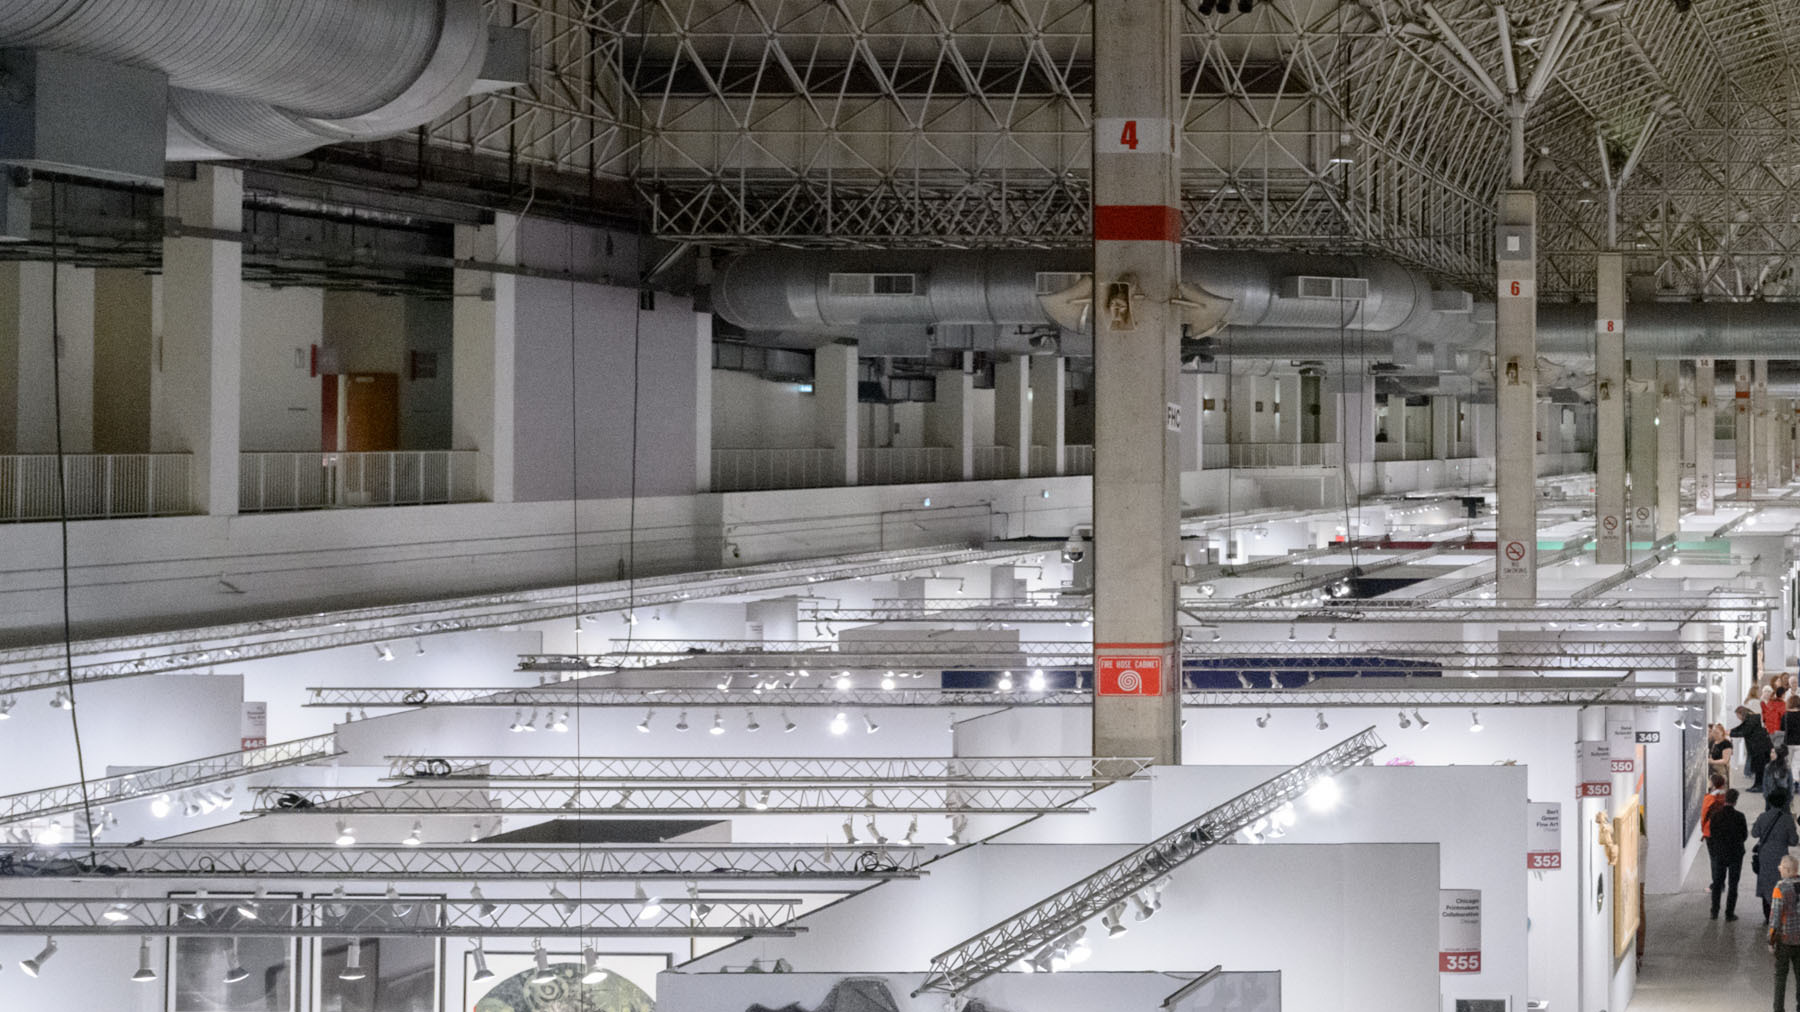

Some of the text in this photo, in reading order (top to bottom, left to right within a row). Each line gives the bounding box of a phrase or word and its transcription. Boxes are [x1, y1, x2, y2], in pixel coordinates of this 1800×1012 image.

[1120, 120, 1139, 150] 4
[1511, 281, 1520, 296] 6
[1607, 320, 1615, 332] 8
[1168, 406, 1180, 428] FHC
[1101, 660, 1158, 668] FIRE HOSE CABINET
[1639, 733, 1659, 742] 349
[1610, 761, 1633, 771] 350
[1586, 784, 1610, 795] 350
[1534, 855, 1560, 867] 352
[1447, 955, 1480, 971] 355
